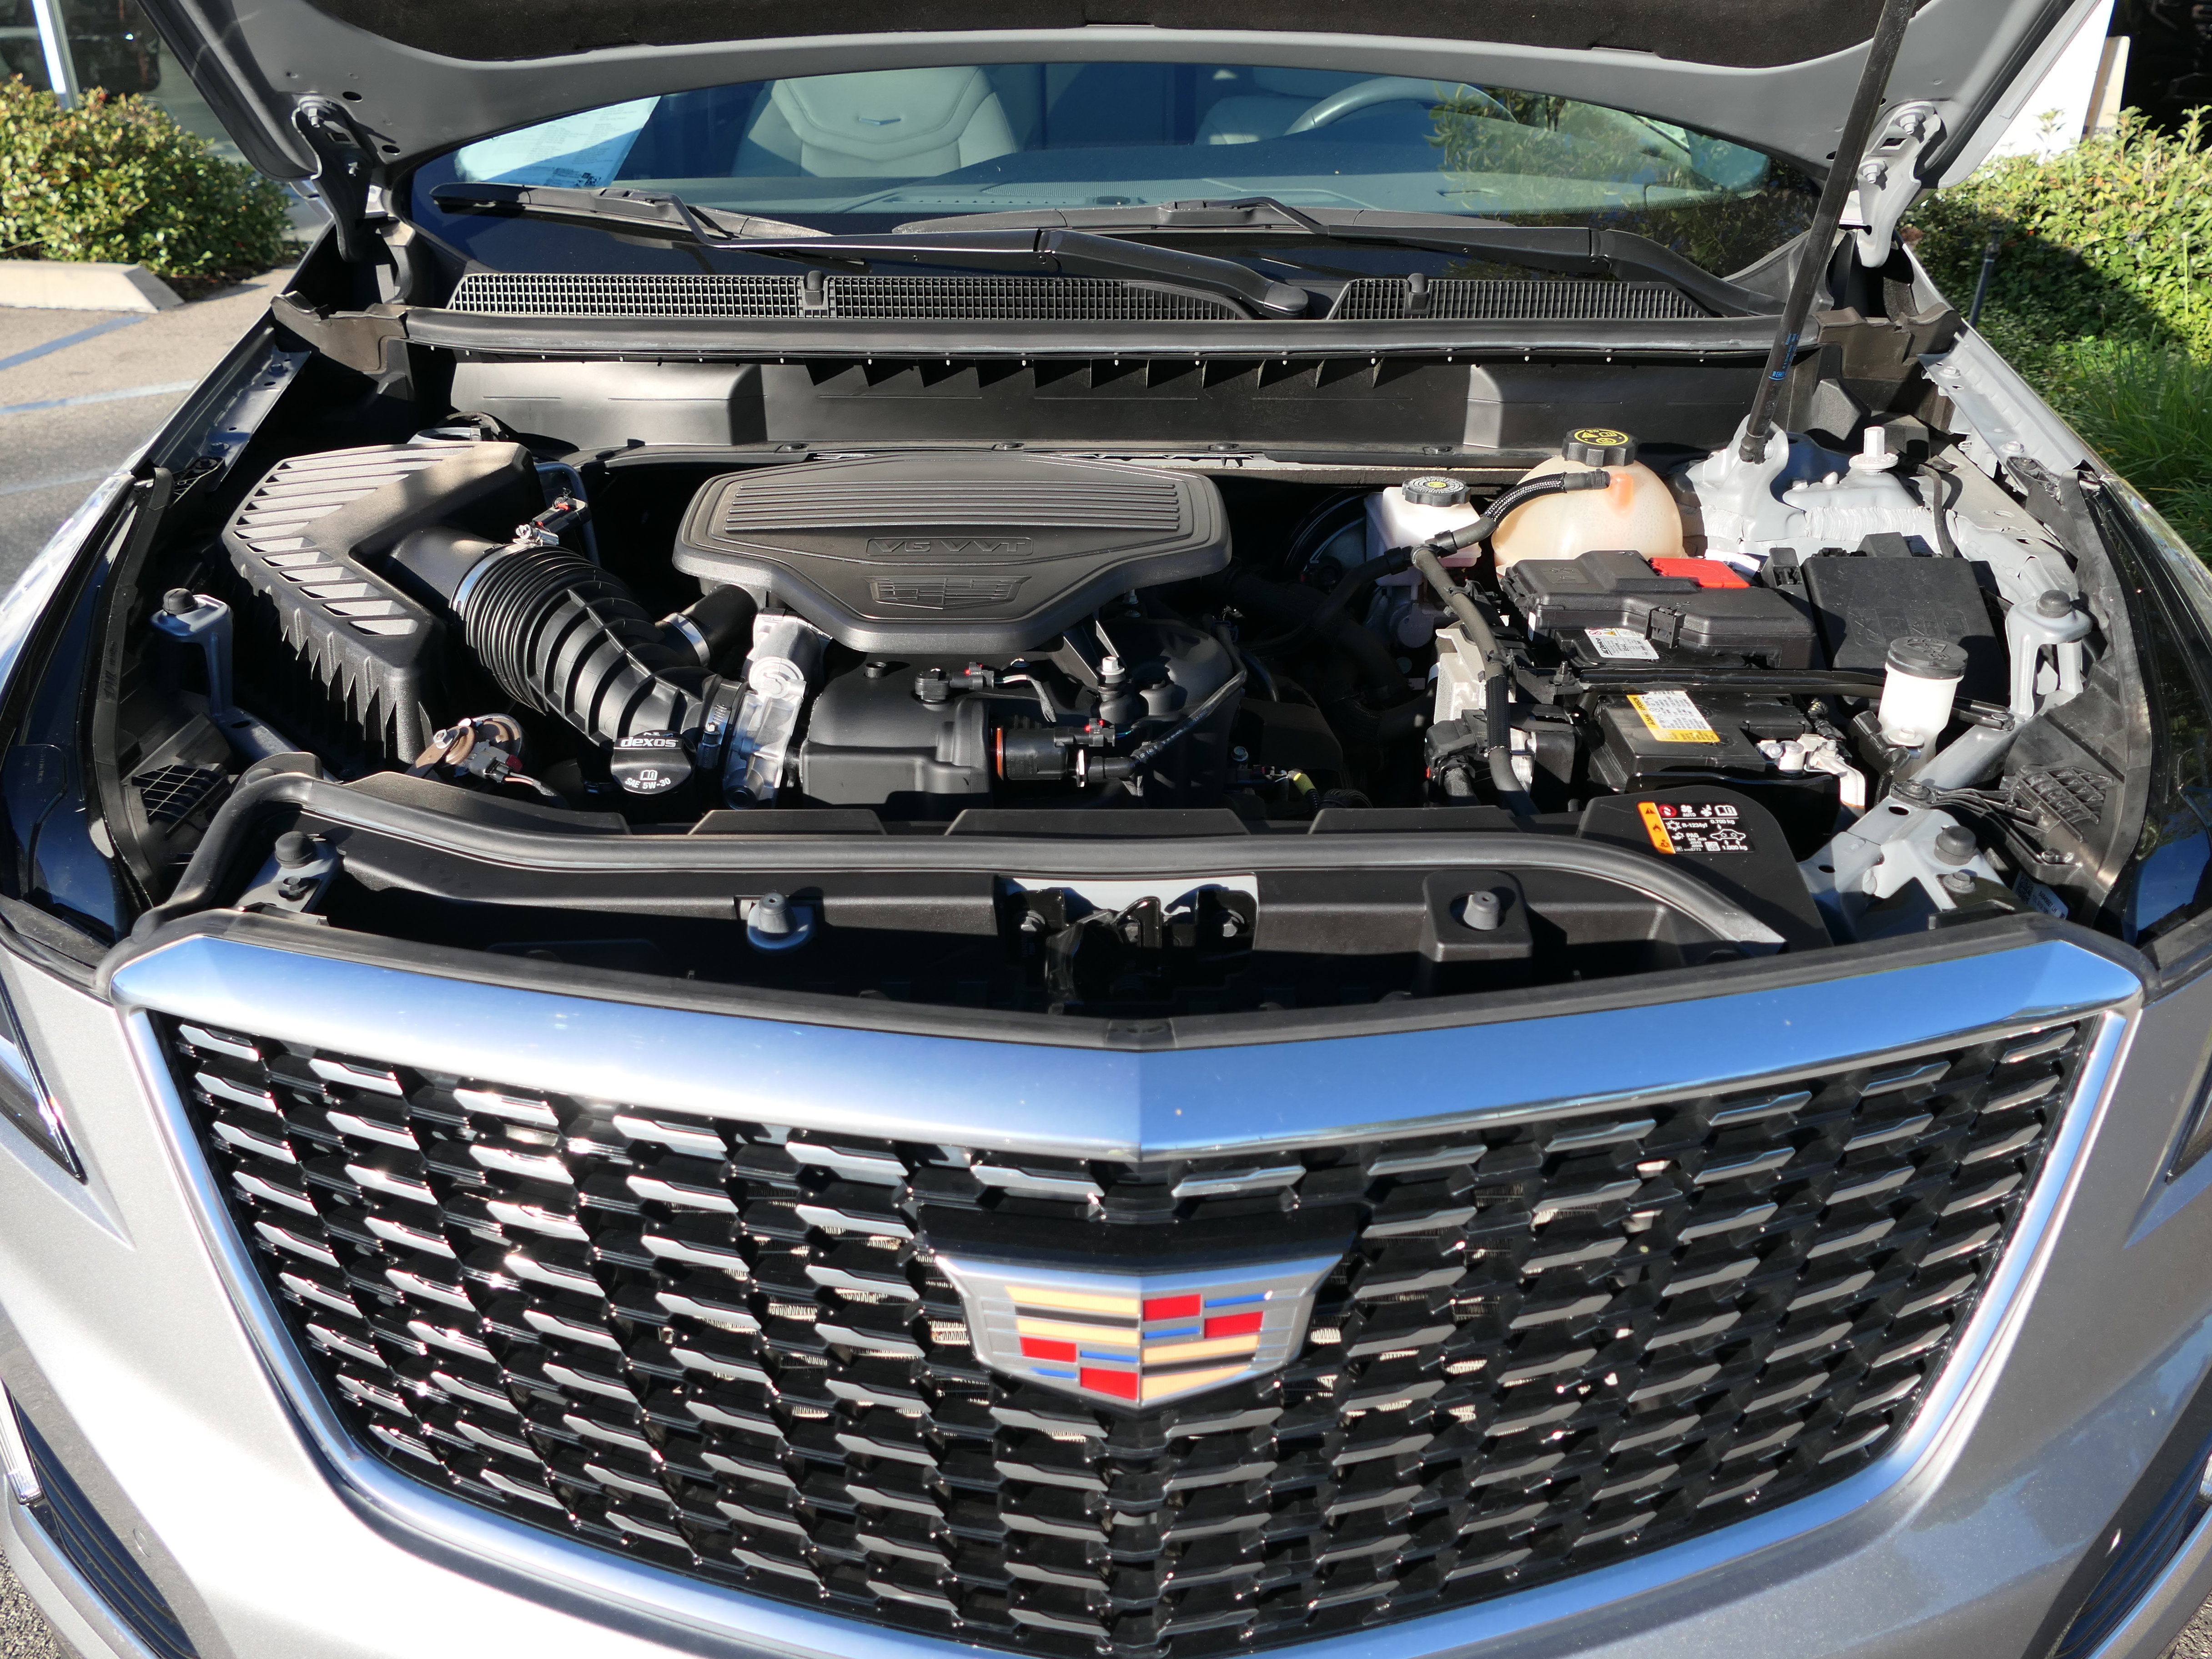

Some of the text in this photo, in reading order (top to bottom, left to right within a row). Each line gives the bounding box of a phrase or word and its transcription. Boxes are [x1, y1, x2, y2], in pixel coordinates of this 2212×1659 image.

[874, 540, 1026, 553] V6 VVT
[621, 737, 677, 747] dexos
[625, 777, 671, 789] SAE 5W-30
